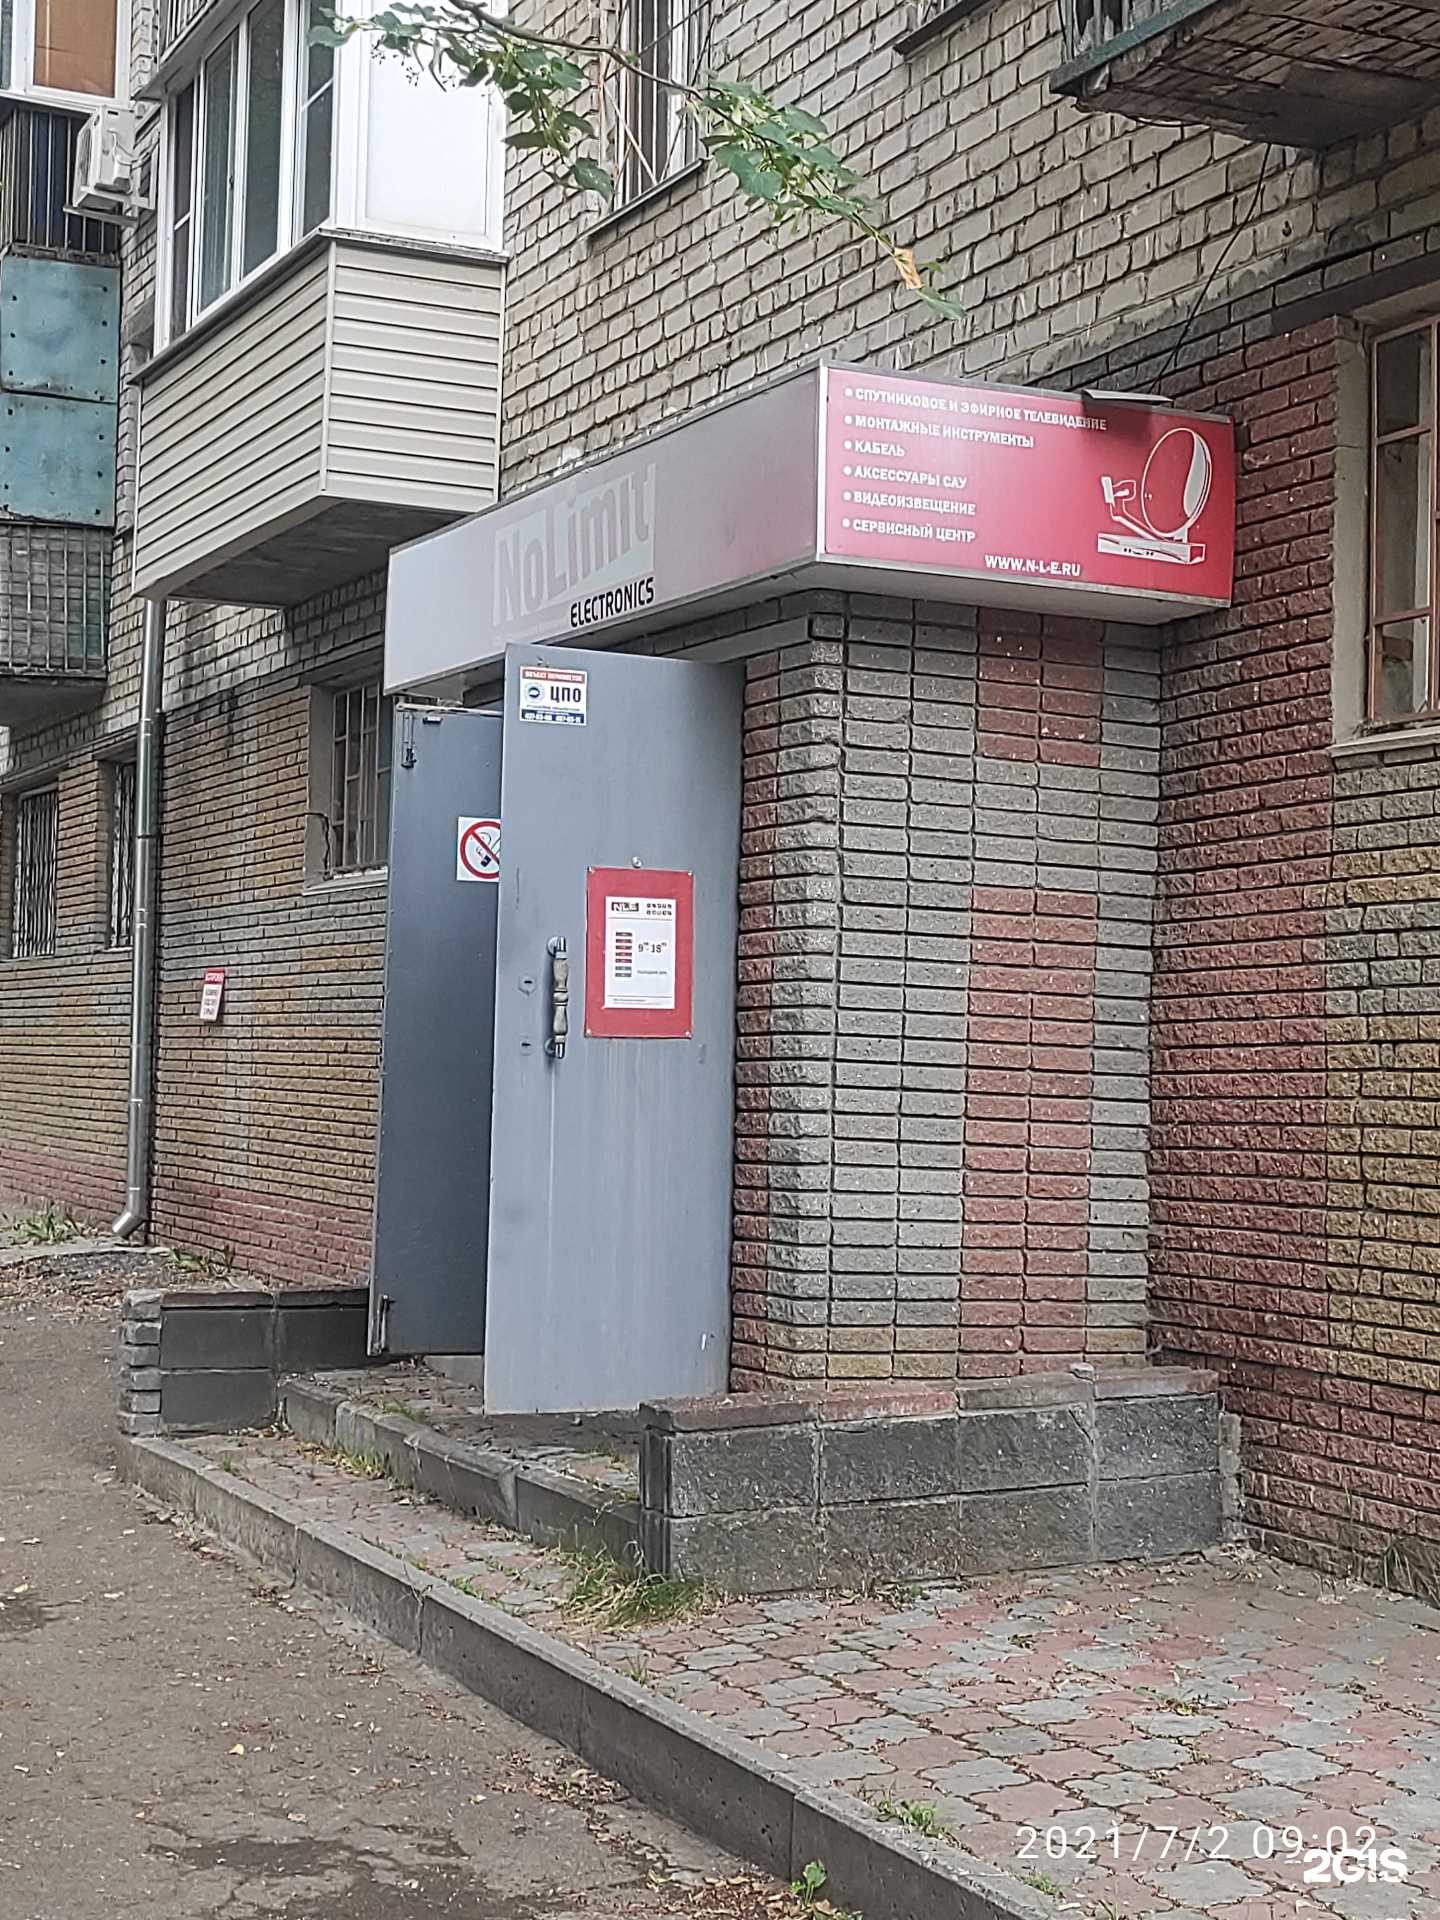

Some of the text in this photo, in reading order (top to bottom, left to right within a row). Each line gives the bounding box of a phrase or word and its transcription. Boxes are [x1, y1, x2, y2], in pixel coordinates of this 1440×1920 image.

[855, 388, 947, 410] СПУТНИКОВОЕ
[949, 400, 959, 412] И
[961, 401, 1021, 420] ЭФИРНОЕ
[855, 415, 1034, 448] МОНТАЖНЫЕ ИНСТРУМЕНТЫ
[855, 440, 905, 457] КАБЕЛЬ
[854, 465, 940, 486] АКСЕССУАРЫ
[854, 491, 976, 515] ВИДЕОИЗВЕЩЕНИЕ
[853, 519, 976, 542] СЕРВИСНЫЙ ЦЕНТР
[570, 577, 654, 628] ELECTRONICS
[550, 681, 581, 703] ЦПО
